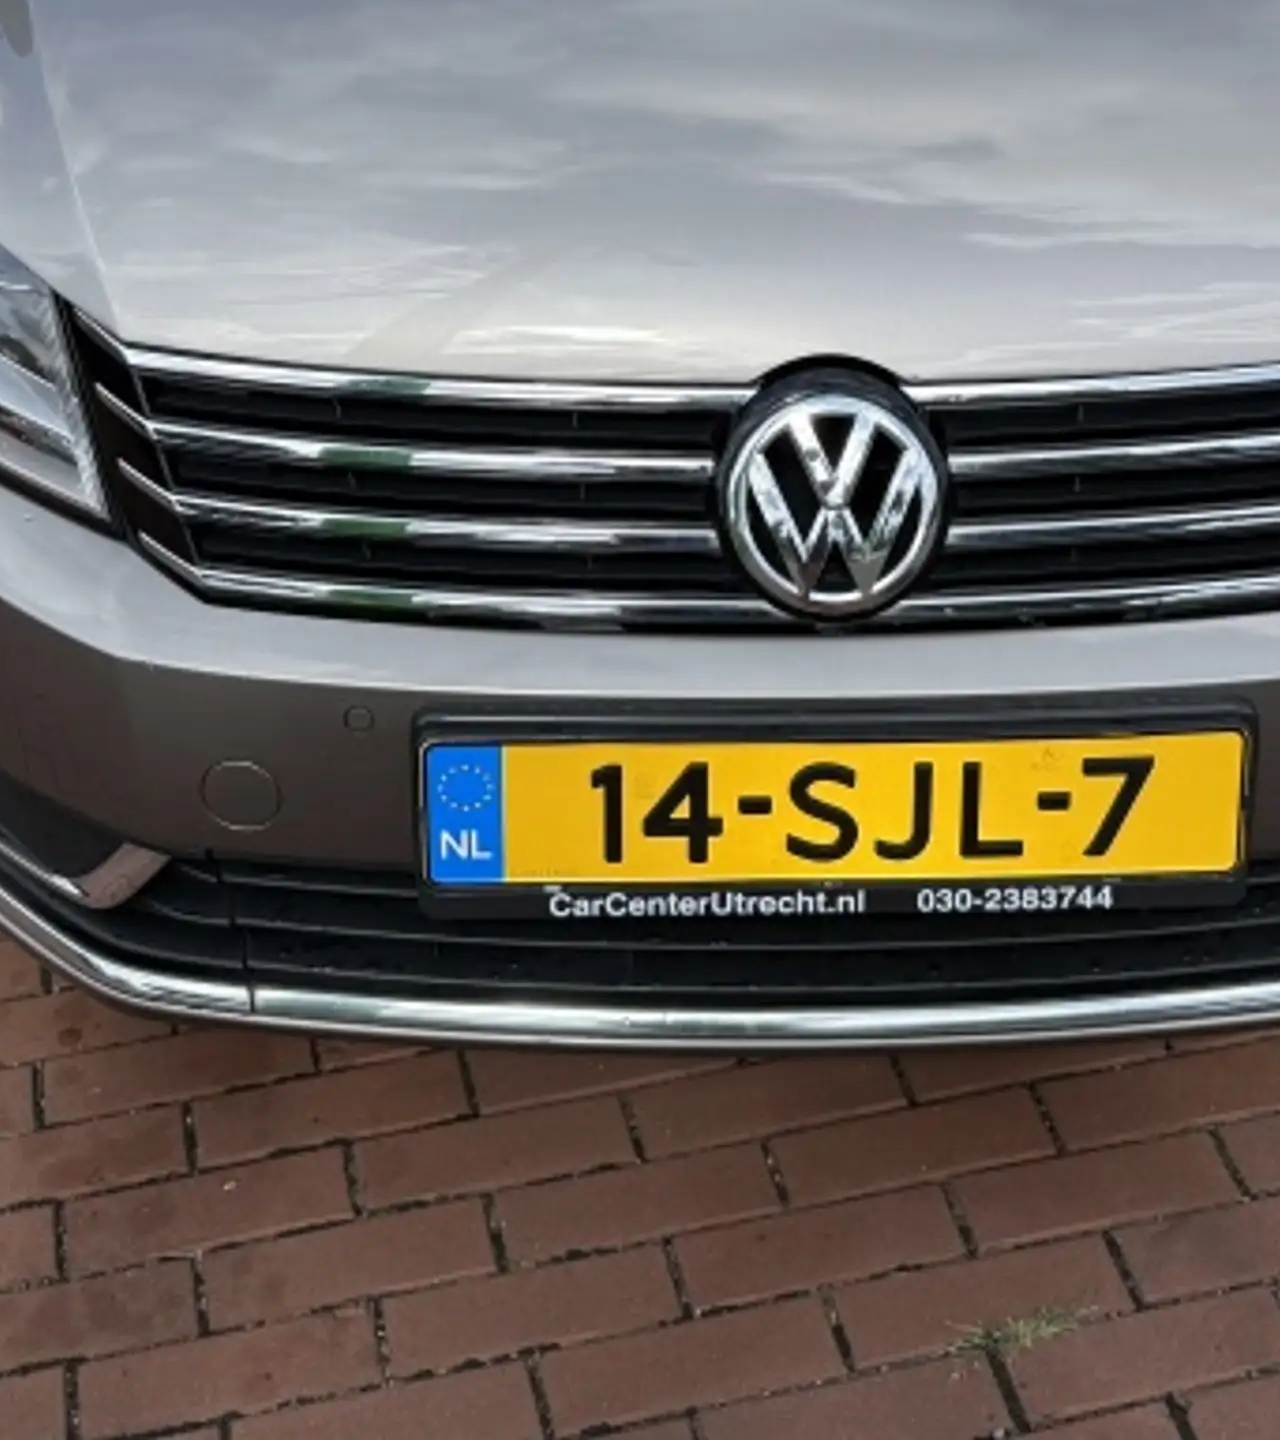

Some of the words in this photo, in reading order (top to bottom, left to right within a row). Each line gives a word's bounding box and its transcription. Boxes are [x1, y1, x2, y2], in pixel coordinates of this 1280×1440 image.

[440, 828, 493, 861] NL
[589, 755, 1157, 865] 14-SJL-7
[548, 888, 866, 918] CarCenterUtrecht.nl
[917, 885, 1113, 914] 030-2383744
